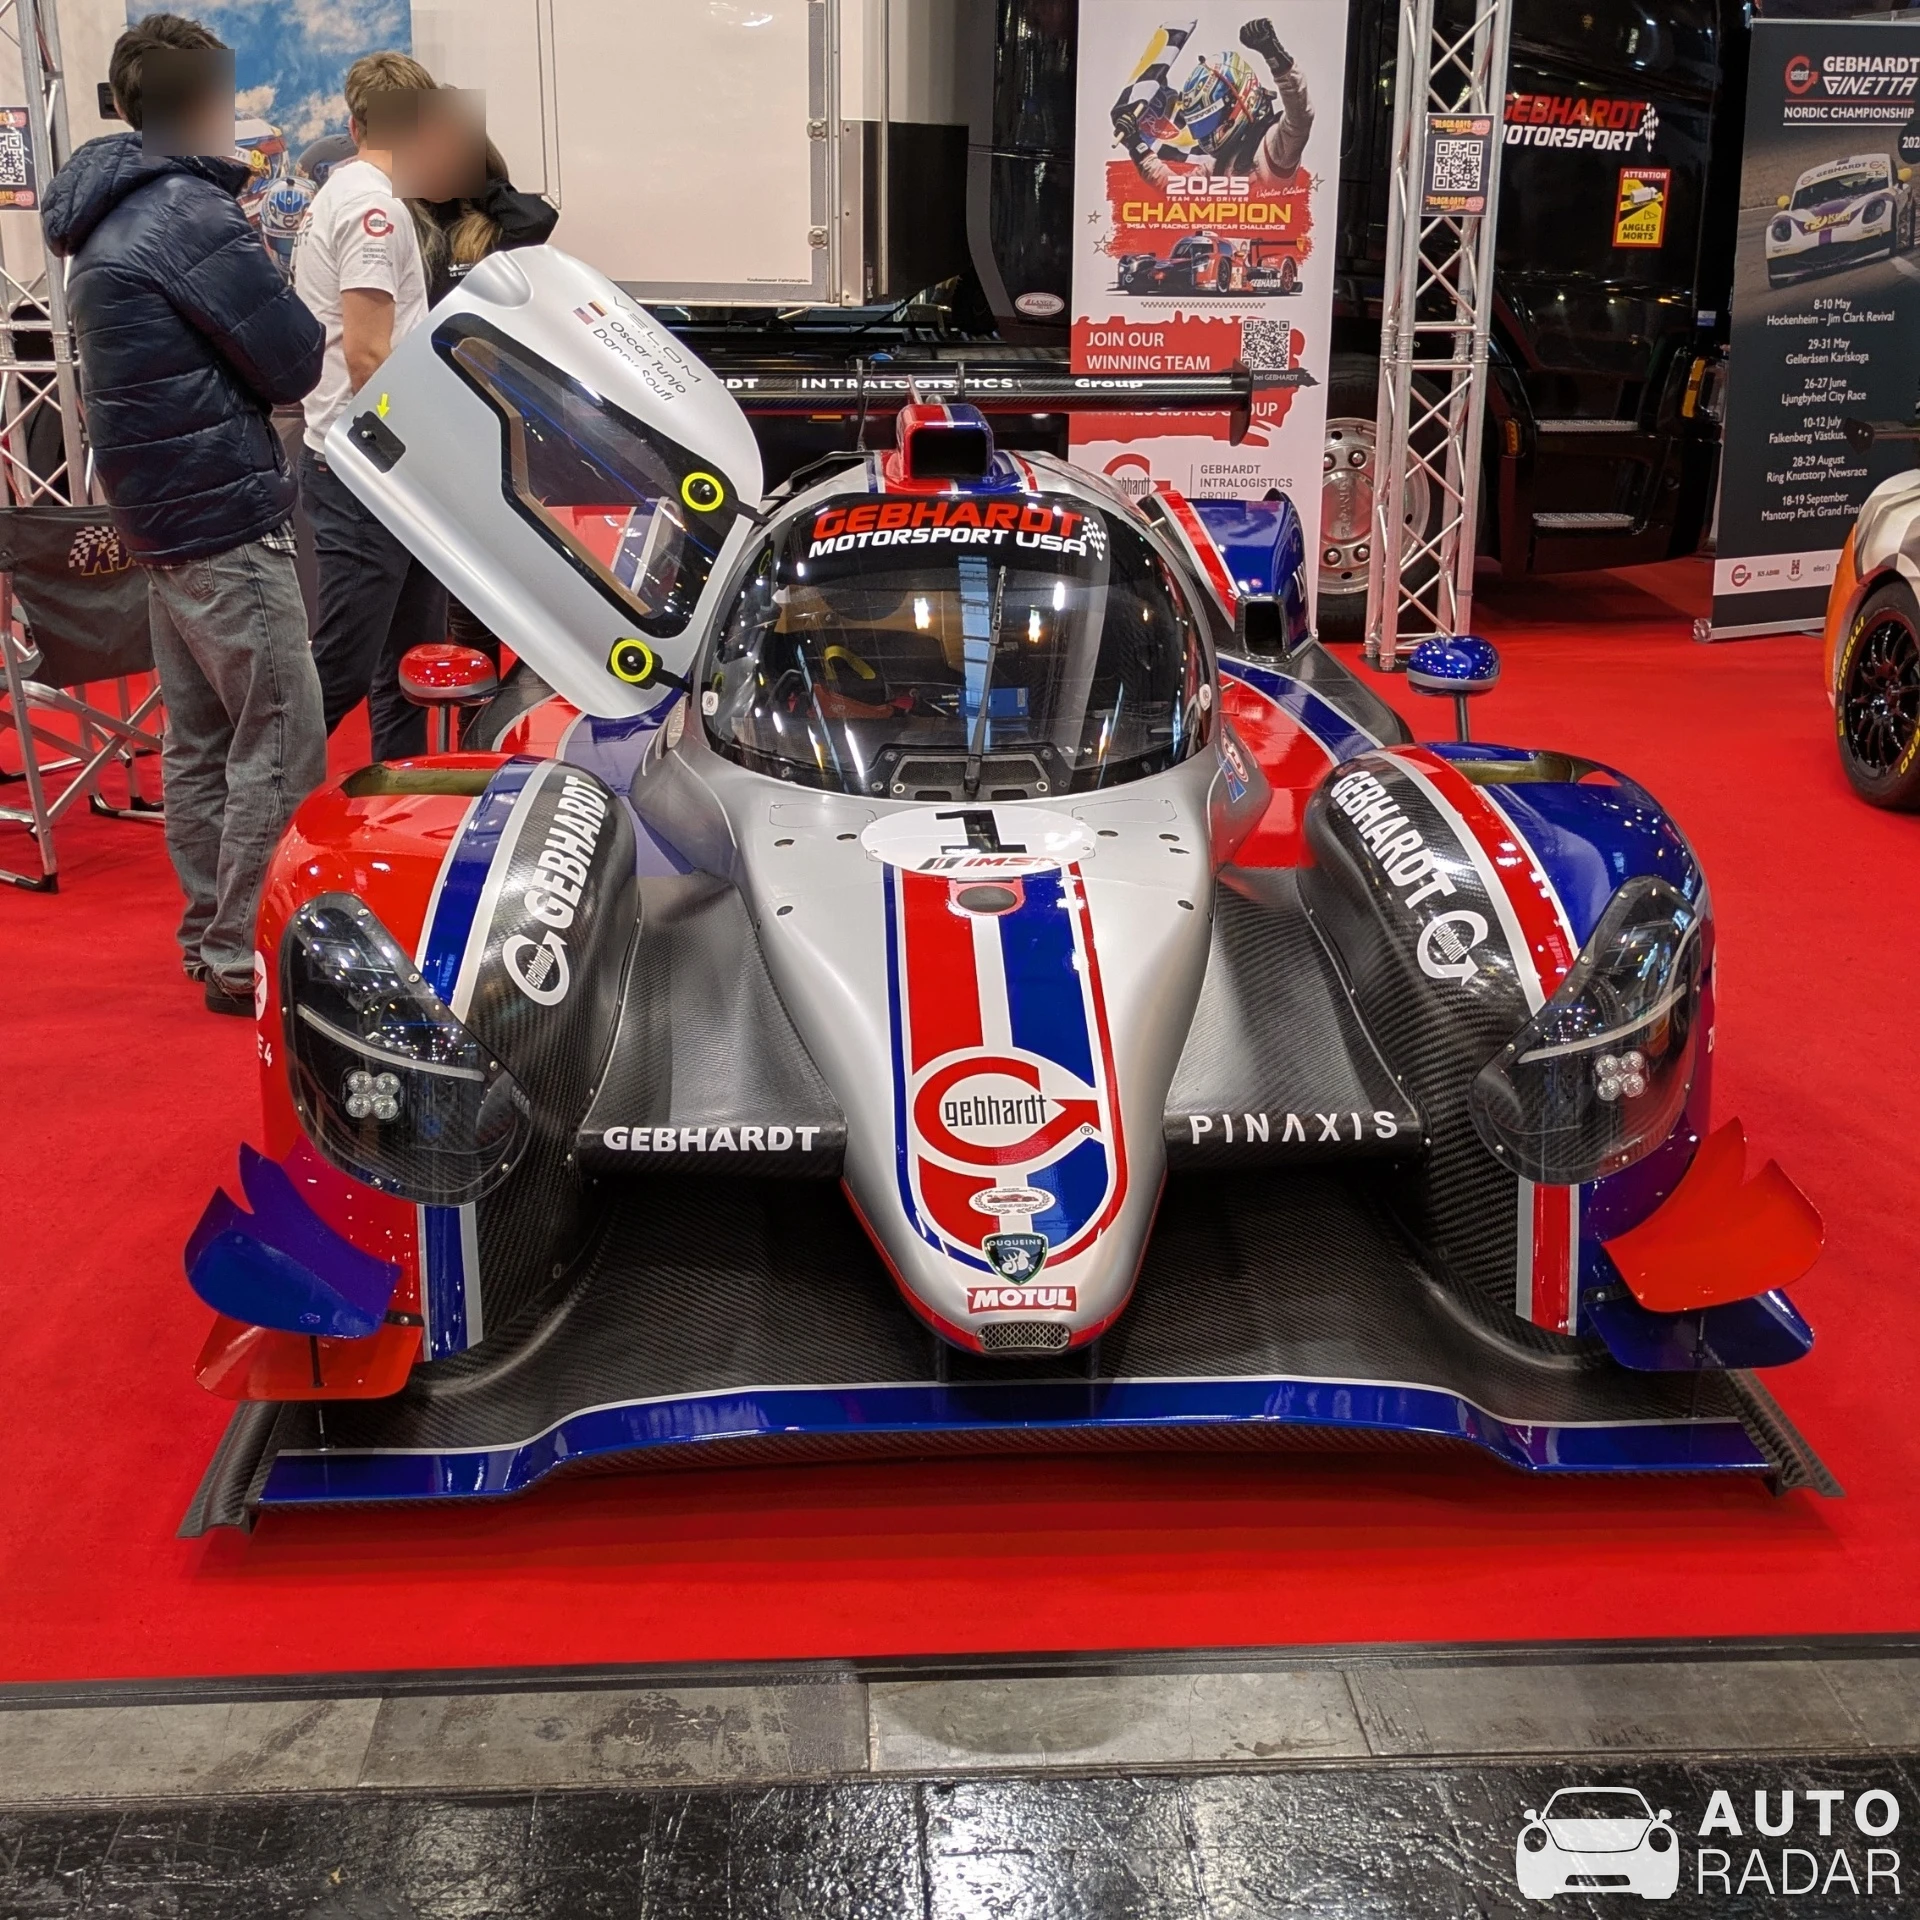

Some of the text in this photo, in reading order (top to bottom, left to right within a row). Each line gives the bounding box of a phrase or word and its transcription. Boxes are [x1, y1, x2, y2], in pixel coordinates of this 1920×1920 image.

[1823, 56, 1920, 73] GEBHARDT
[1823, 76, 1918, 95] GINETTA
[1784, 106, 1914, 118] NORDIC CHAMPIONSHIP
[1624, 171, 1667, 179] ATTENTION
[1166, 176, 1250, 195] 2025
[1122, 202, 1291, 223] CHAMPION
[1622, 224, 1656, 232] ANGLES
[1623, 232, 1653, 240] MORTS
[1814, 298, 1851, 311] 8-10 May
[1767, 315, 1818, 326] Hockenheim
[1827, 313, 1841, 326] Jim
[1843, 312, 1864, 323] Clark
[1867, 310, 1895, 322] Revival
[1086, 332, 1164, 347] JOIN OUR
[1808, 338, 1850, 351] 29-31 May
[610, 321, 652, 359] Oscar
[651, 359, 686, 394] Tunjo
[1086, 355, 1210, 371] WINNING TEAM
[1785, 351, 1869, 365] Gelleråsen Karlskoga
[801, 378, 1013, 390] INTRALOGISTICS
[1075, 378, 1143, 389] Group
[1253, 373, 1298, 382] bei GEBHARDT
[1804, 377, 1847, 391] 26-27 June
[1781, 389, 1867, 407] Ljungbyhed City Race
[1803, 415, 1842, 430] 10-12 July
[1768, 430, 1847, 445] Falkenberg Västkus
[1792, 454, 1845, 467] 28-29 August
[1200, 464, 1261, 475] GEBHARDT
[1766, 467, 1868, 485] Ring Knutstorp Newsrace
[1200, 477, 1293, 488] INTRALOGISTICS
[1200, 491, 1238, 499] GROUP
[1782, 491, 1849, 506] 18-19 September
[1761, 510, 1796, 522] Mantorp
[1797, 507, 1815, 519] Park
[1817, 504, 1841, 517] Grand
[813, 502, 1082, 540] GEBHARDT
[808, 528, 1087, 558] MOTORSPORT USA
[1838, 616, 1865, 691] PIRELLI
[935, 809, 1027, 854] 1
[1331, 770, 1457, 910] GEBHARDT
[524, 775, 608, 929] GEBHARDT
[944, 1094, 1047, 1127] gebhardt
[603, 1126, 820, 1152] GEBHARDT
[989, 1238, 1042, 1247] DUQUEINE
[972, 1288, 1073, 1309] MOTUL
